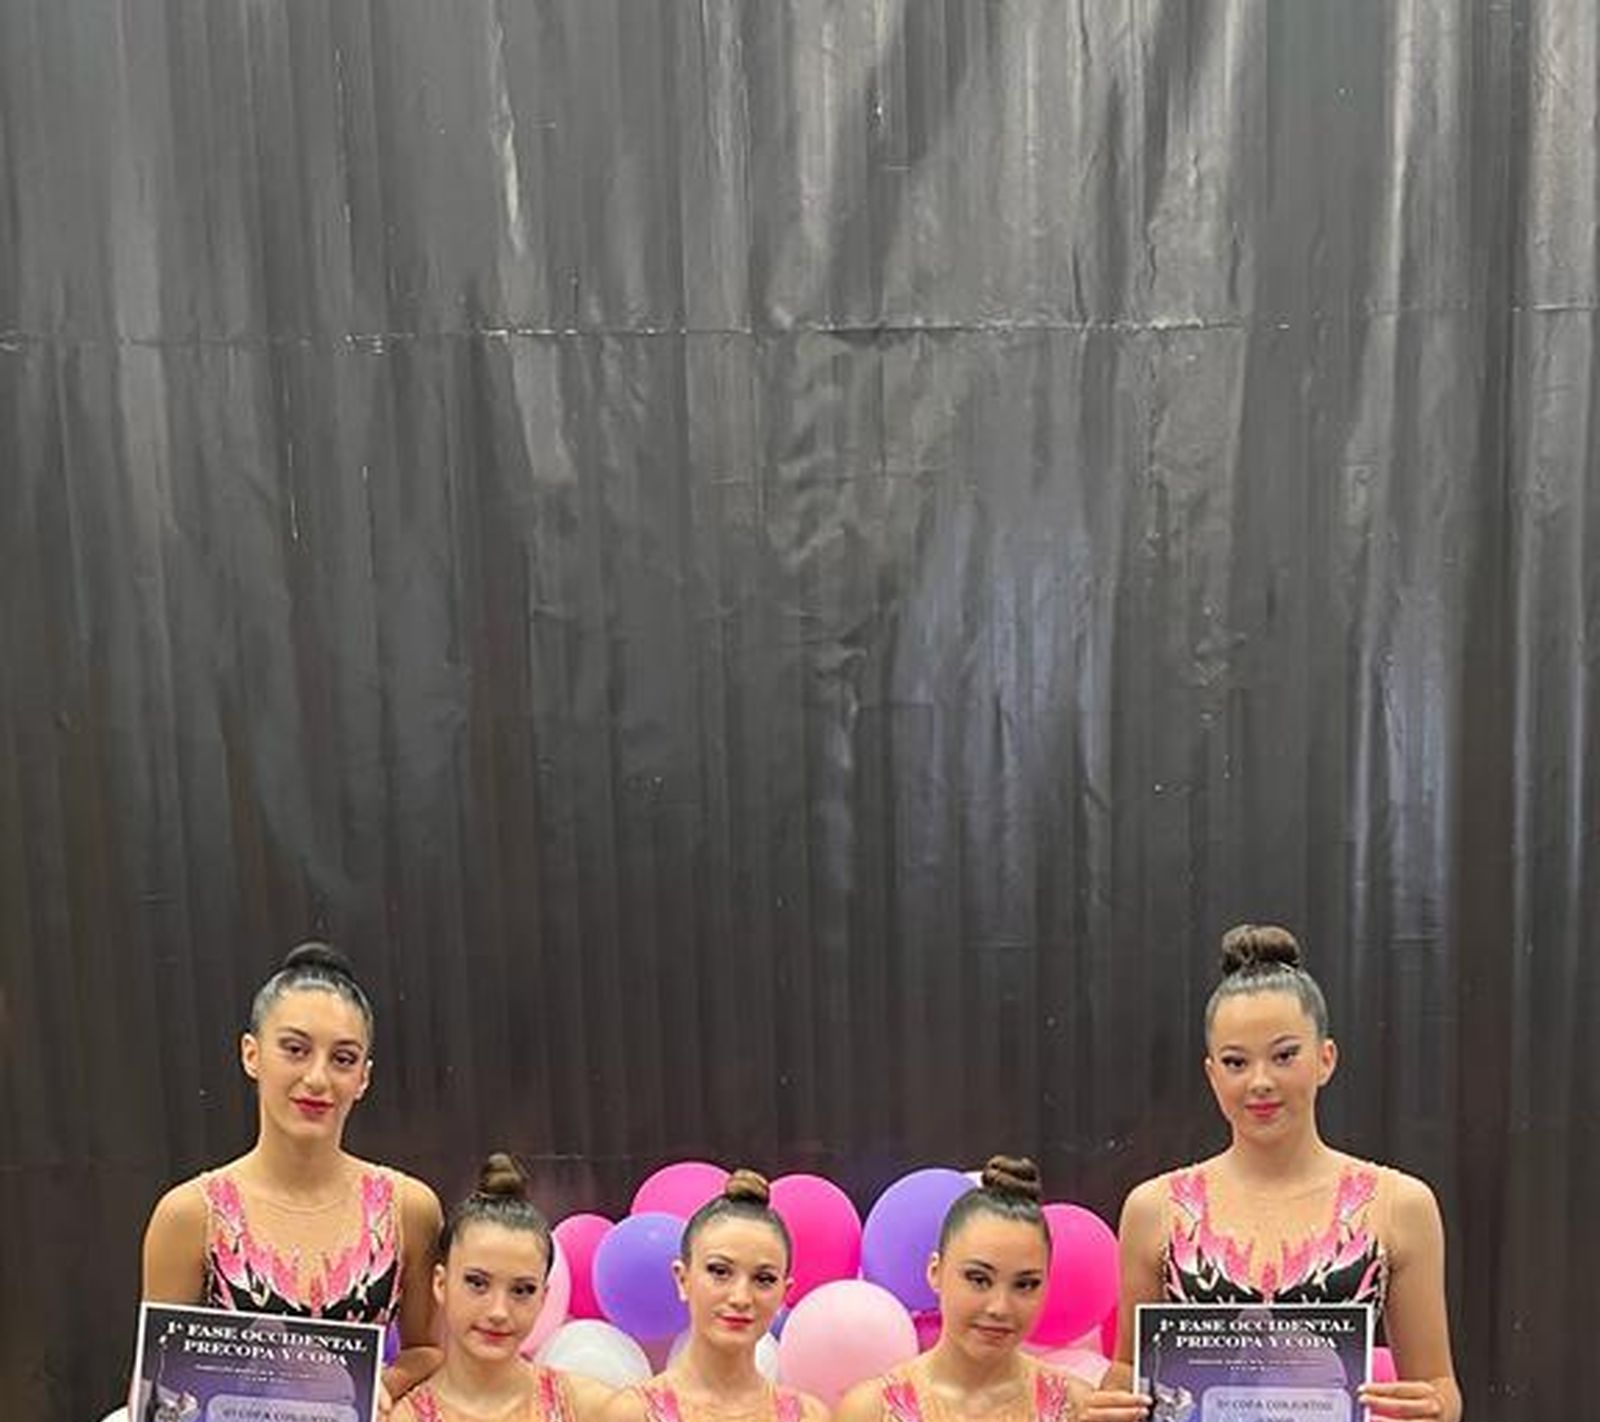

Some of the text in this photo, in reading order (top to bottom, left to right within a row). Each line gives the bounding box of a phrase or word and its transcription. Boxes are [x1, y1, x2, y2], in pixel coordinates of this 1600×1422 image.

[1179, 1319, 1226, 1332] FASE
[1229, 1318, 1356, 1332] OCCIDENTAL
[188, 1323, 238, 1340] FASE
[241, 1328, 367, 1351] OCCIDENTAL
[1176, 1335, 1338, 1348] PRECOPA Y COPA
[183, 1340, 348, 1366] PRECOPA Y COPA
